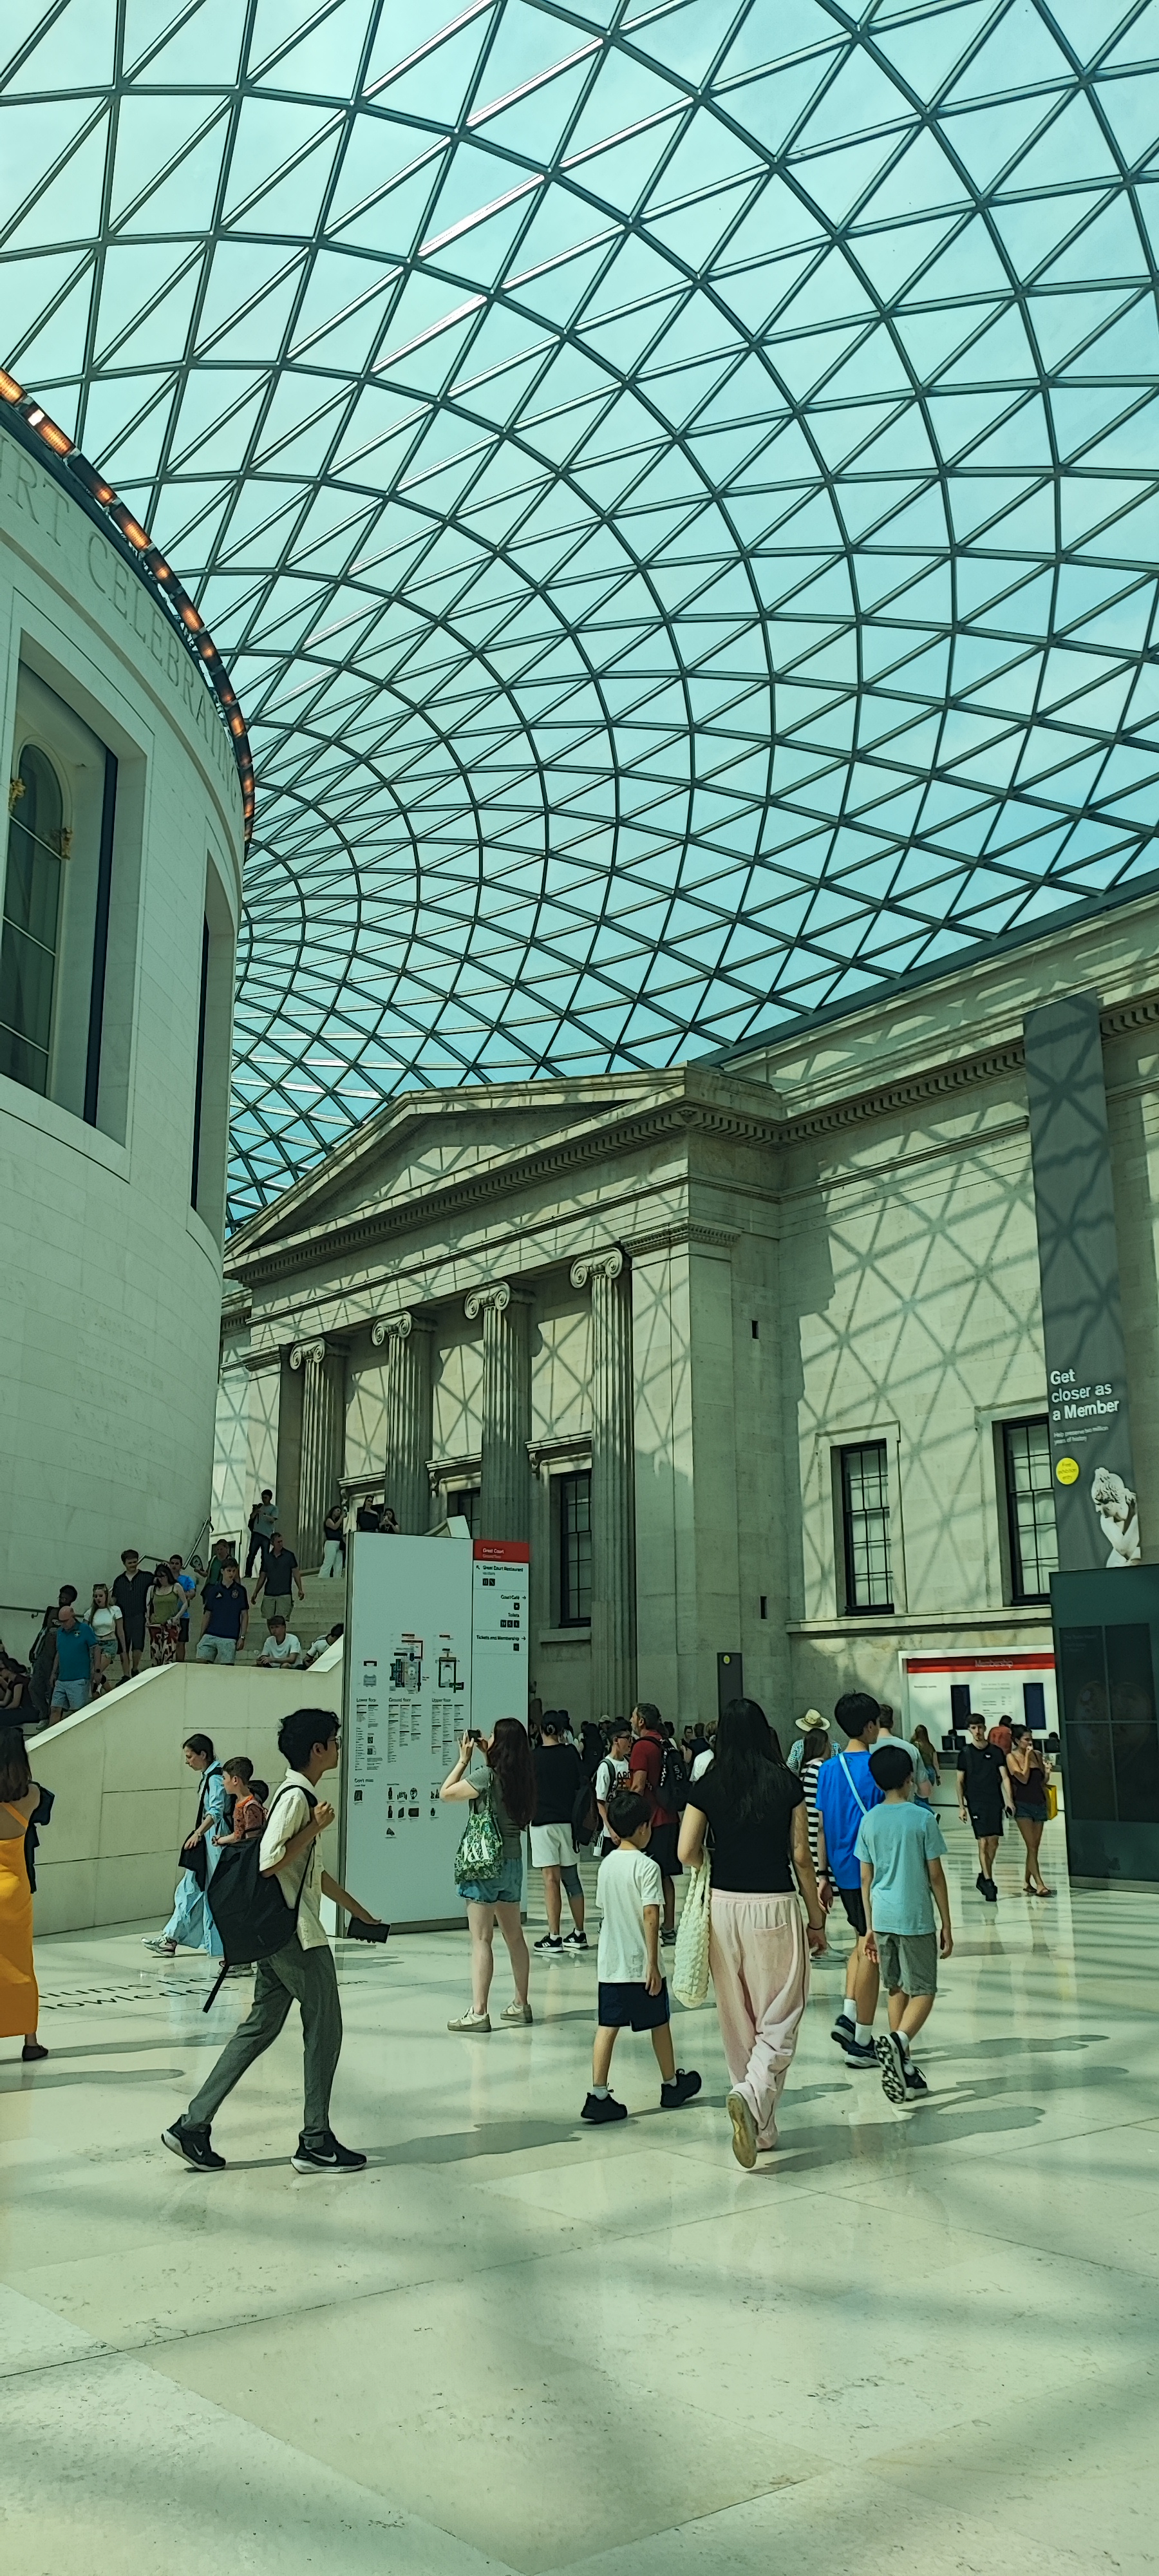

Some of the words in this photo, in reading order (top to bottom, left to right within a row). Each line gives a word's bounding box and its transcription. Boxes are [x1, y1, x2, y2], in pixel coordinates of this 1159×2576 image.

[88, 530, 237, 813] CELEBRATING
[1050, 1368, 1076, 1385] Get
[1051, 1387, 1091, 1403] closer
[1095, 1383, 1112, 1396] as
[1052, 1410, 1061, 1421] a
[1064, 1399, 1120, 1419] Member
[975, 1658, 1013, 1669] Membership
